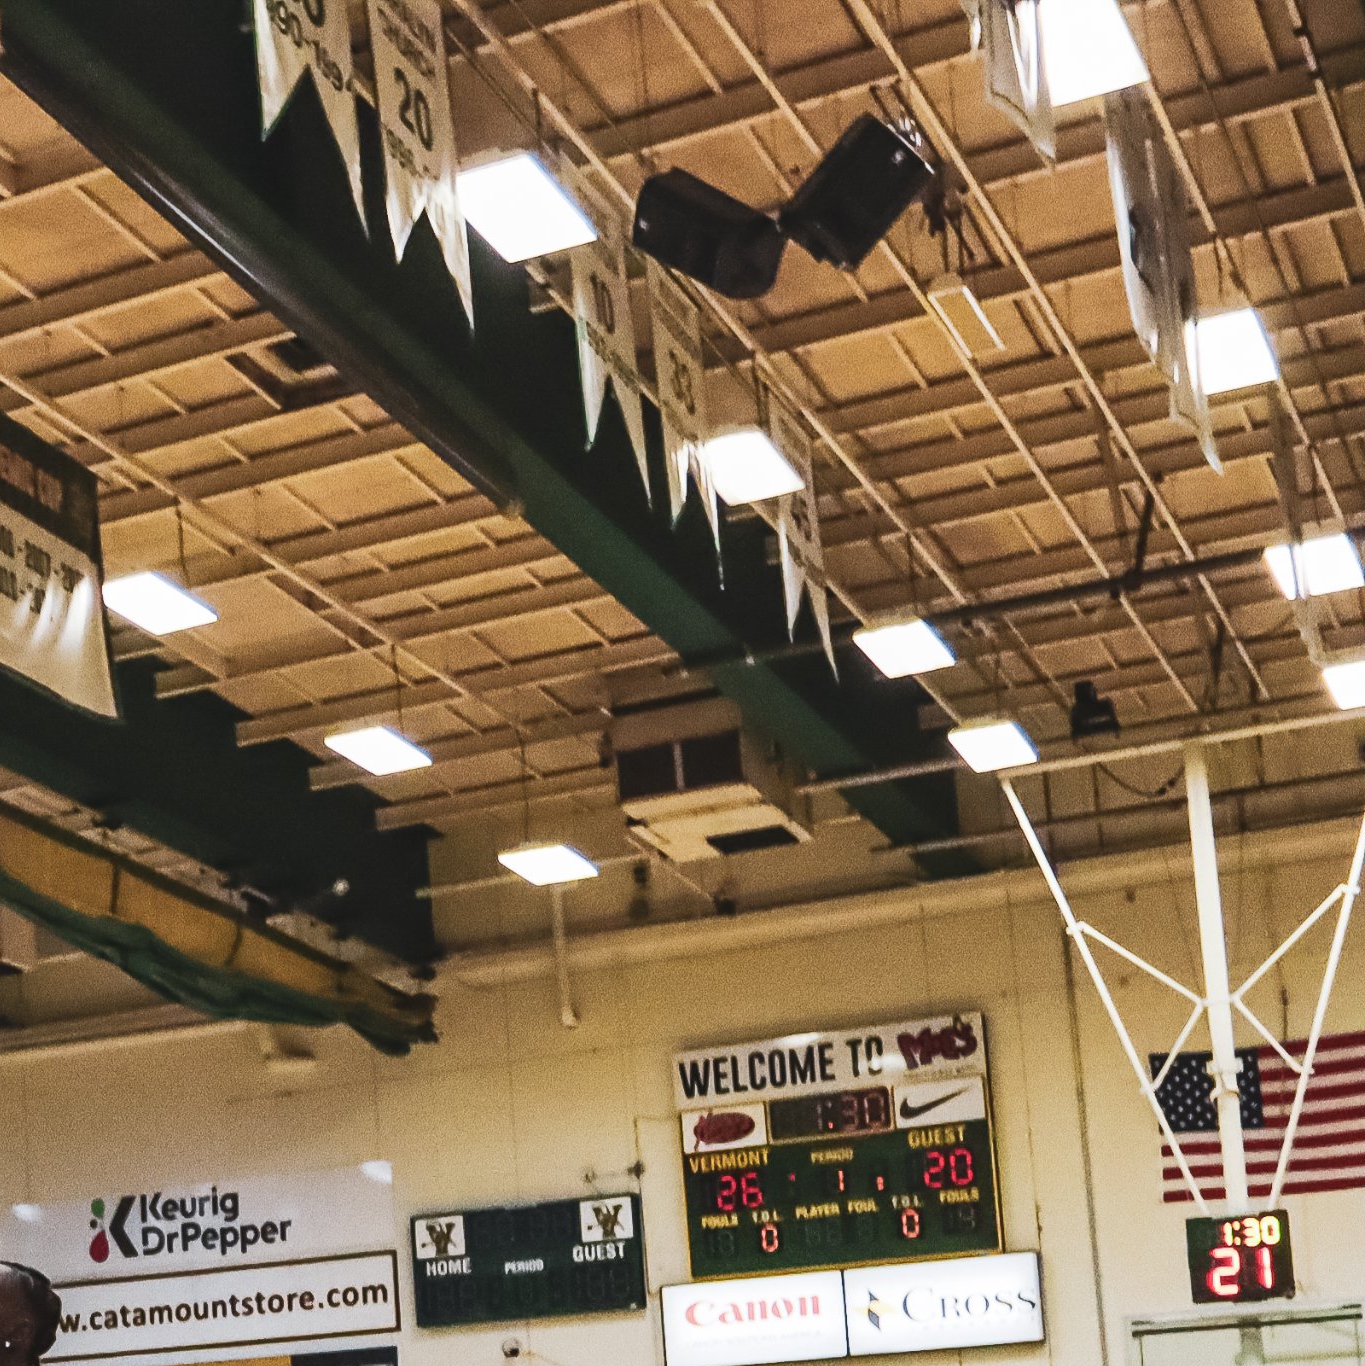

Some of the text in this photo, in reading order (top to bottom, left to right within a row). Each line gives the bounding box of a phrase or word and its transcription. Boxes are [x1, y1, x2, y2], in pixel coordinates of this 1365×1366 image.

[394, 67, 433, 151] 20
[678, 1044, 836, 1099] WELCOME
[846, 1035, 883, 1077] TO
[908, 1124, 965, 1149] GUEST
[689, 1148, 769, 1173] VERMONT
[924, 1148, 973, 1188] 20
[140, 1186, 239, 1223] Keurig
[717, 1172, 763, 1211] 26
[761, 1223, 779, 1252] 0
[901, 1208, 919, 1238] 0
[1223, 1215, 1281, 1247] 1:30
[426, 1258, 472, 1276] HOME
[572, 1242, 626, 1263] GUEST
[1206, 1247, 1275, 1296] 21
[685, 1296, 820, 1327] Canon
